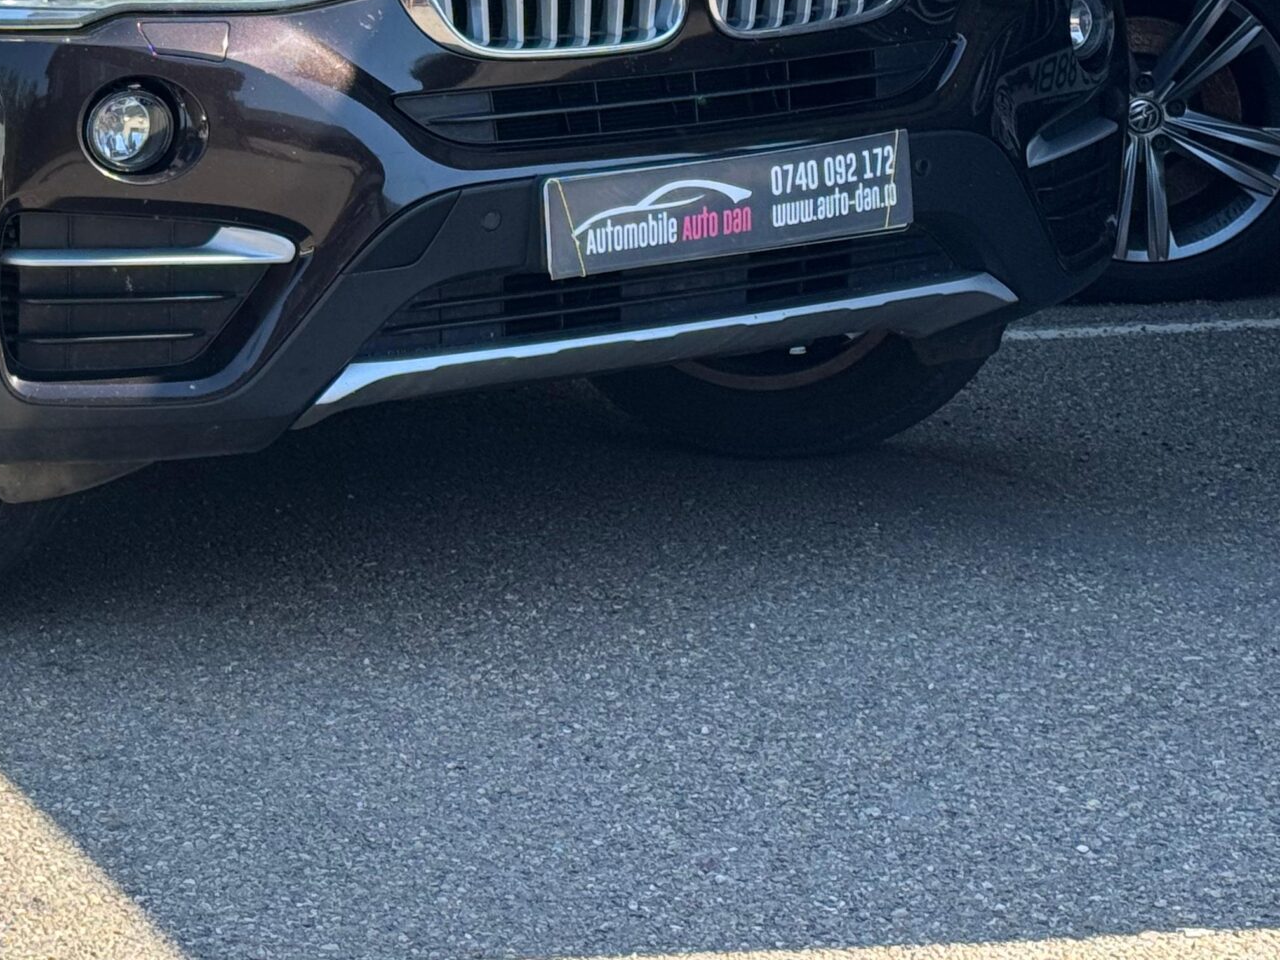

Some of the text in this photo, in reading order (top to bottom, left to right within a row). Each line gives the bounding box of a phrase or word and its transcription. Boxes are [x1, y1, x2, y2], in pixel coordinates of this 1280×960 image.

[770, 145, 895, 196] 0740 092 172
[772, 181, 897, 228] www.auto-dan.ro
[586, 211, 678, 255] Automobile
